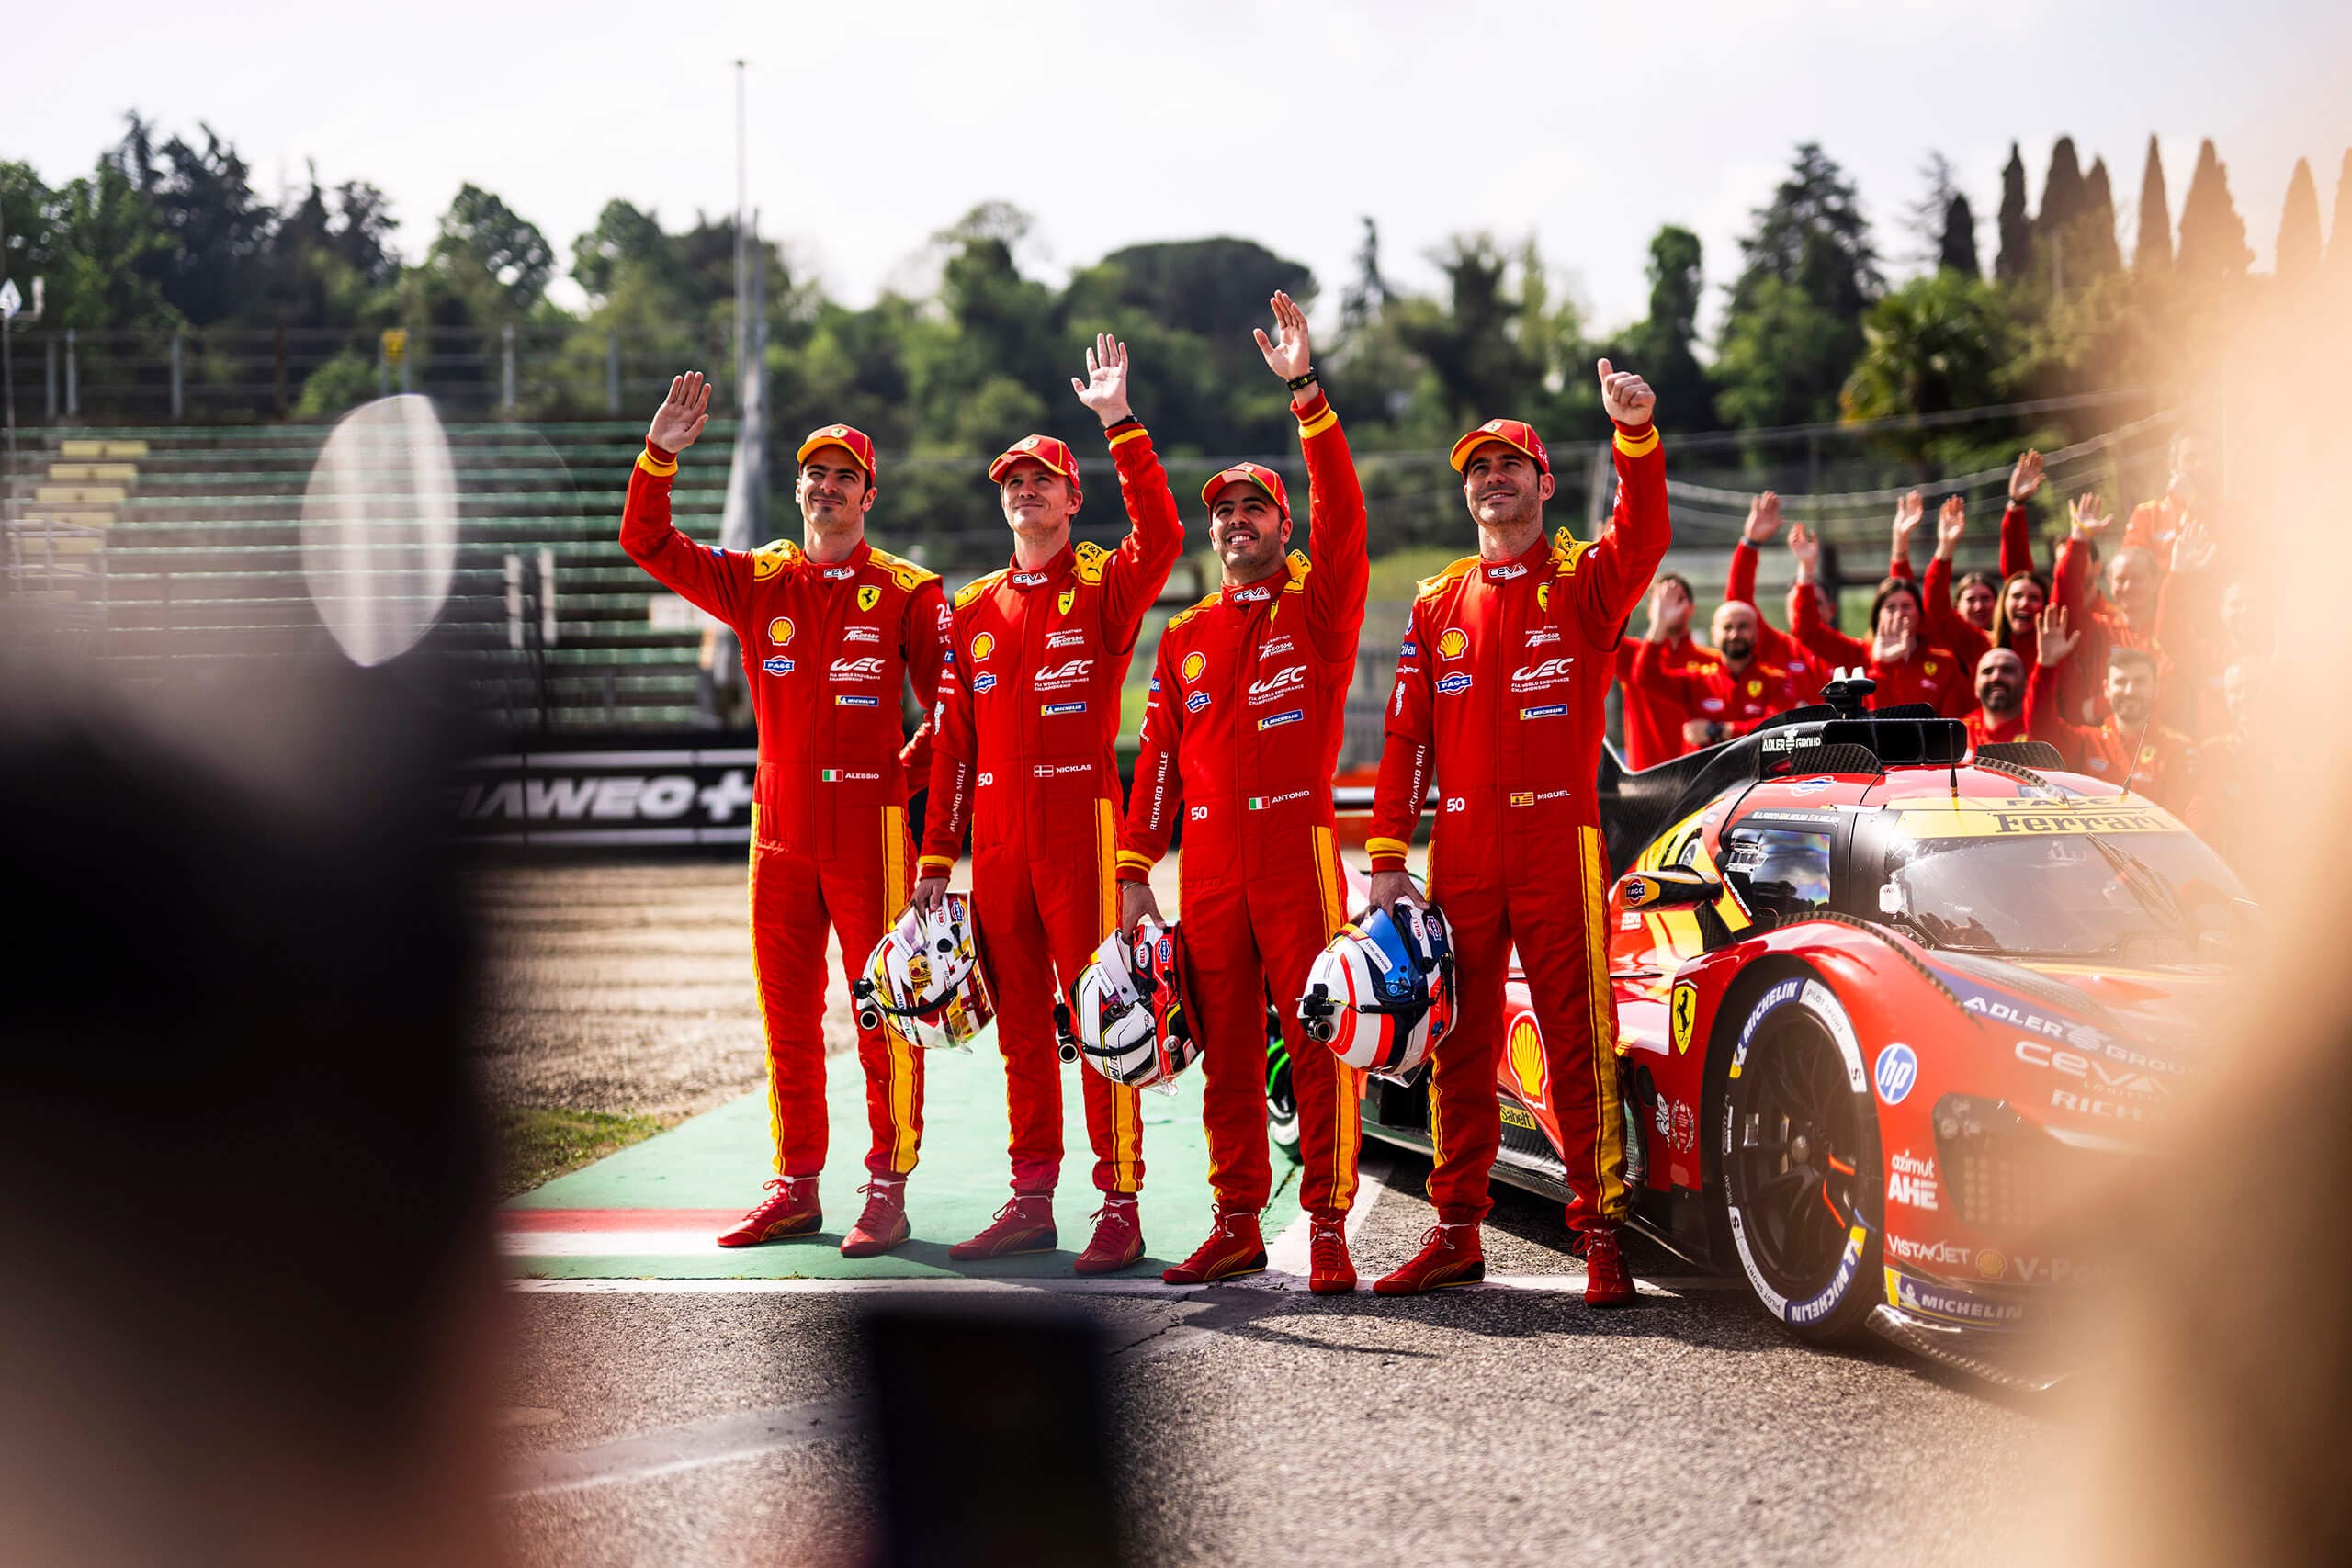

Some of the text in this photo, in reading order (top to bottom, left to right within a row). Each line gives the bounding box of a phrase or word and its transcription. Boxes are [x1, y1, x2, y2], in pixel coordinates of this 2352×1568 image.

[830, 657, 886, 673] WEC
[1035, 660, 1094, 681] WEC
[1511, 658, 1574, 682] WEC
[1249, 665, 1307, 694] WEC
[1761, 738, 1786, 752] ADLER
[844, 772, 880, 780] ALESSIO
[978, 763, 1092, 787] 50 NICKLAS
[1149, 750, 1169, 830] RICHARD MILLE
[1446, 789, 1571, 813] 50 MIGUEL
[1191, 789, 1310, 821] 50 ANTONIO
[1992, 813, 2166, 833] Ferrari
[1805, 987, 1825, 1006] PILOT
[1743, 981, 1798, 1043] MICHELIN
[1963, 996, 2064, 1038] ADLER
[1879, 1044, 1915, 1104] hp
[1500, 1105, 1532, 1128] Sabelt
[1891, 1148, 1934, 1179] azimut
[1886, 1233, 1971, 1265] VISTAJET
[1791, 1263, 1850, 1323] MICHELIN
[1920, 1293, 2022, 1318] MICHELIN
